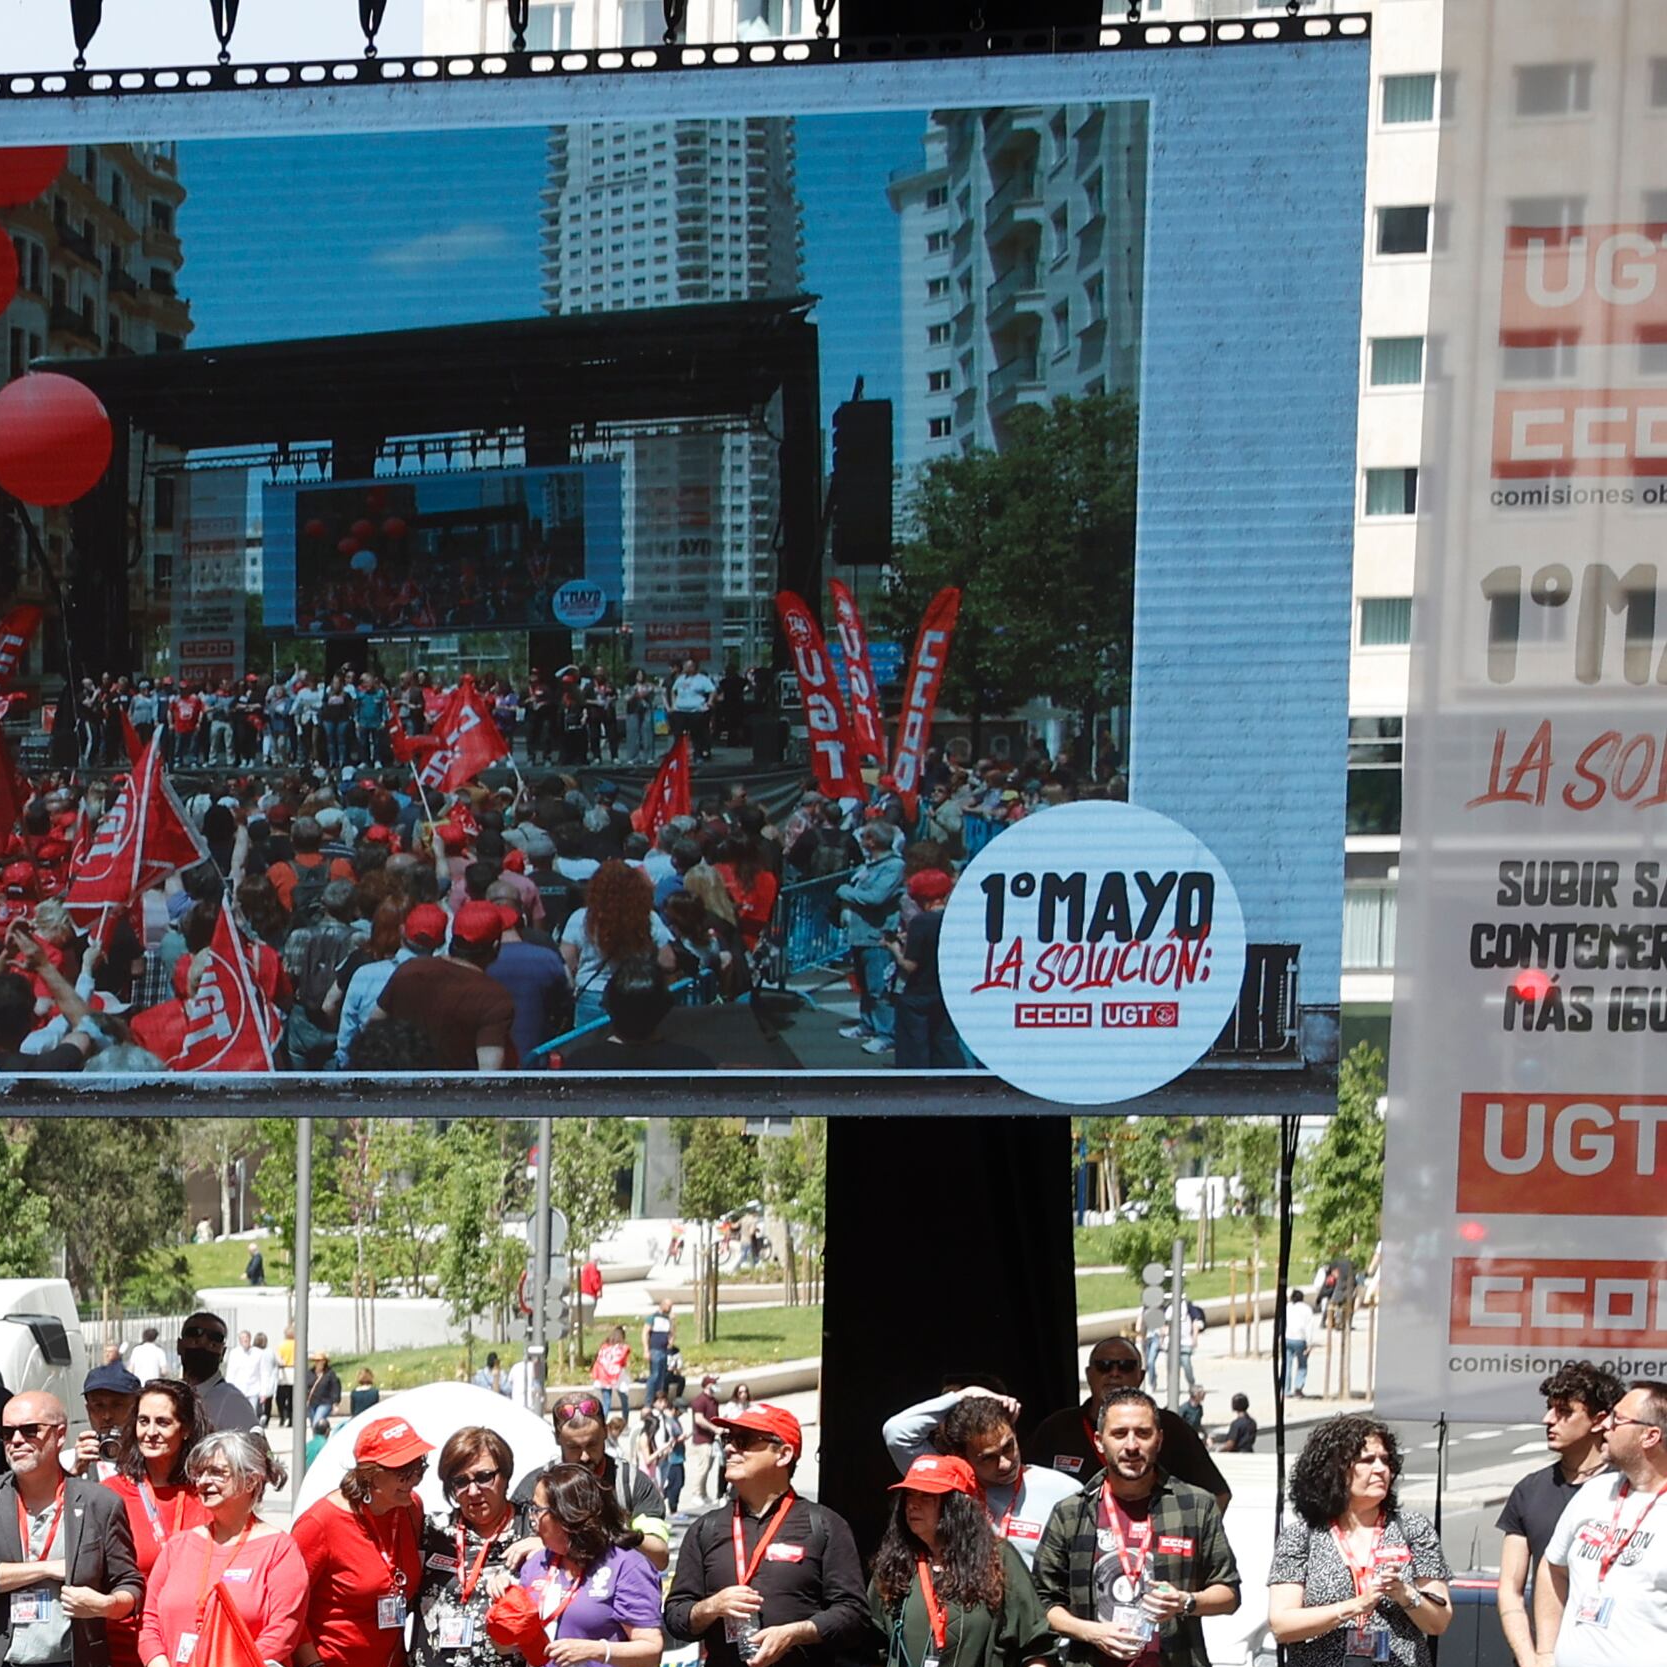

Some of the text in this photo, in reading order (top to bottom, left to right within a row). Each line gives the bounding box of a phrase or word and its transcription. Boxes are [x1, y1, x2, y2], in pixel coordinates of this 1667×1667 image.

[1490, 482, 1635, 507] comisiones
[794, 646, 846, 780] UGT
[1466, 719, 1554, 811] LA
[1497, 861, 1620, 907] SUBIR
[971, 936, 1024, 994] LA
[1105, 1006, 1153, 1025] UGT
[1504, 973, 1594, 1032] MÁS
[1469, 1277, 1667, 1331] CCO
